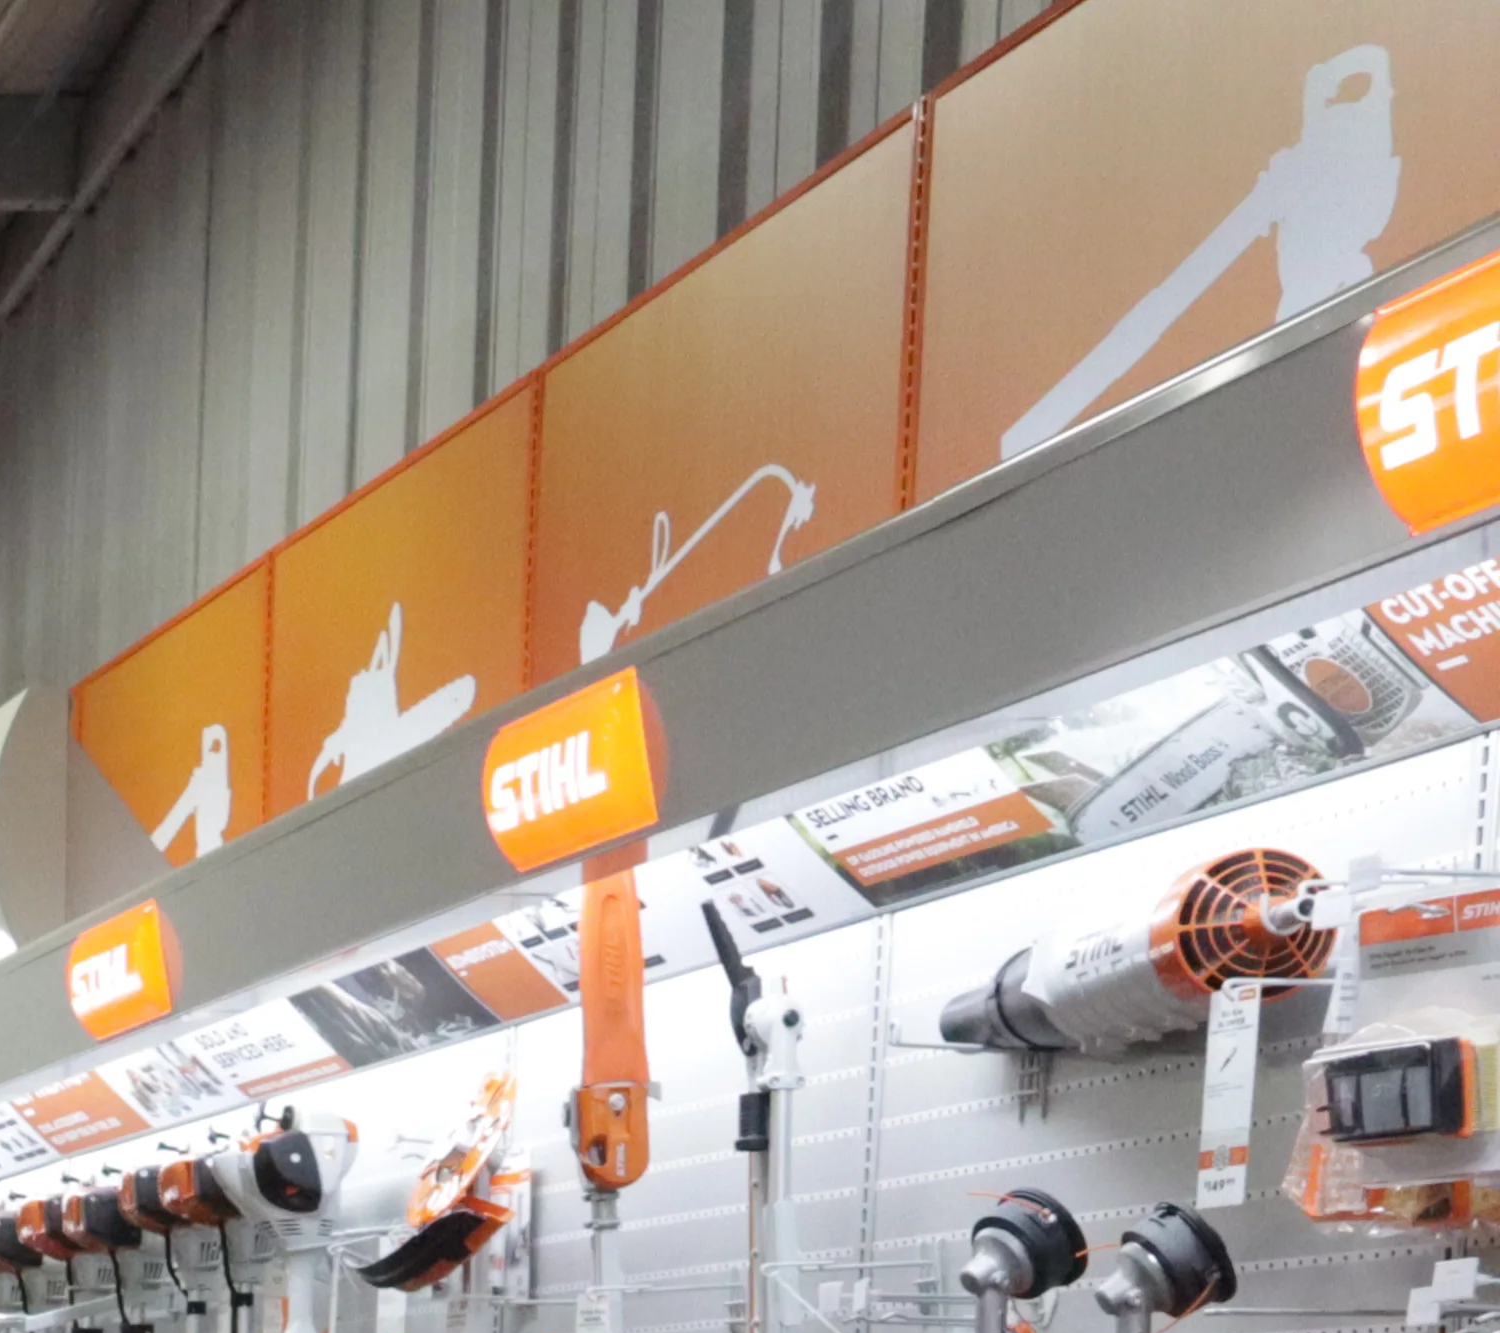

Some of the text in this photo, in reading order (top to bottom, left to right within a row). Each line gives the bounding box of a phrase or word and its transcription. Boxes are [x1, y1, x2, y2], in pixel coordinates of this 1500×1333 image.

[1380, 321, 1500, 471] ST
[1381, 559, 1500, 624] CUT-OFF
[1408, 600, 1500, 656] MACHI
[489, 730, 608, 832] STIHL
[806, 775, 925, 829] SELLING BRAND
[1120, 785, 1170, 822] STIHL
[1160, 754, 1198, 789] Wood
[1462, 901, 1500, 920] STIH
[70, 942, 144, 1017] STIHL
